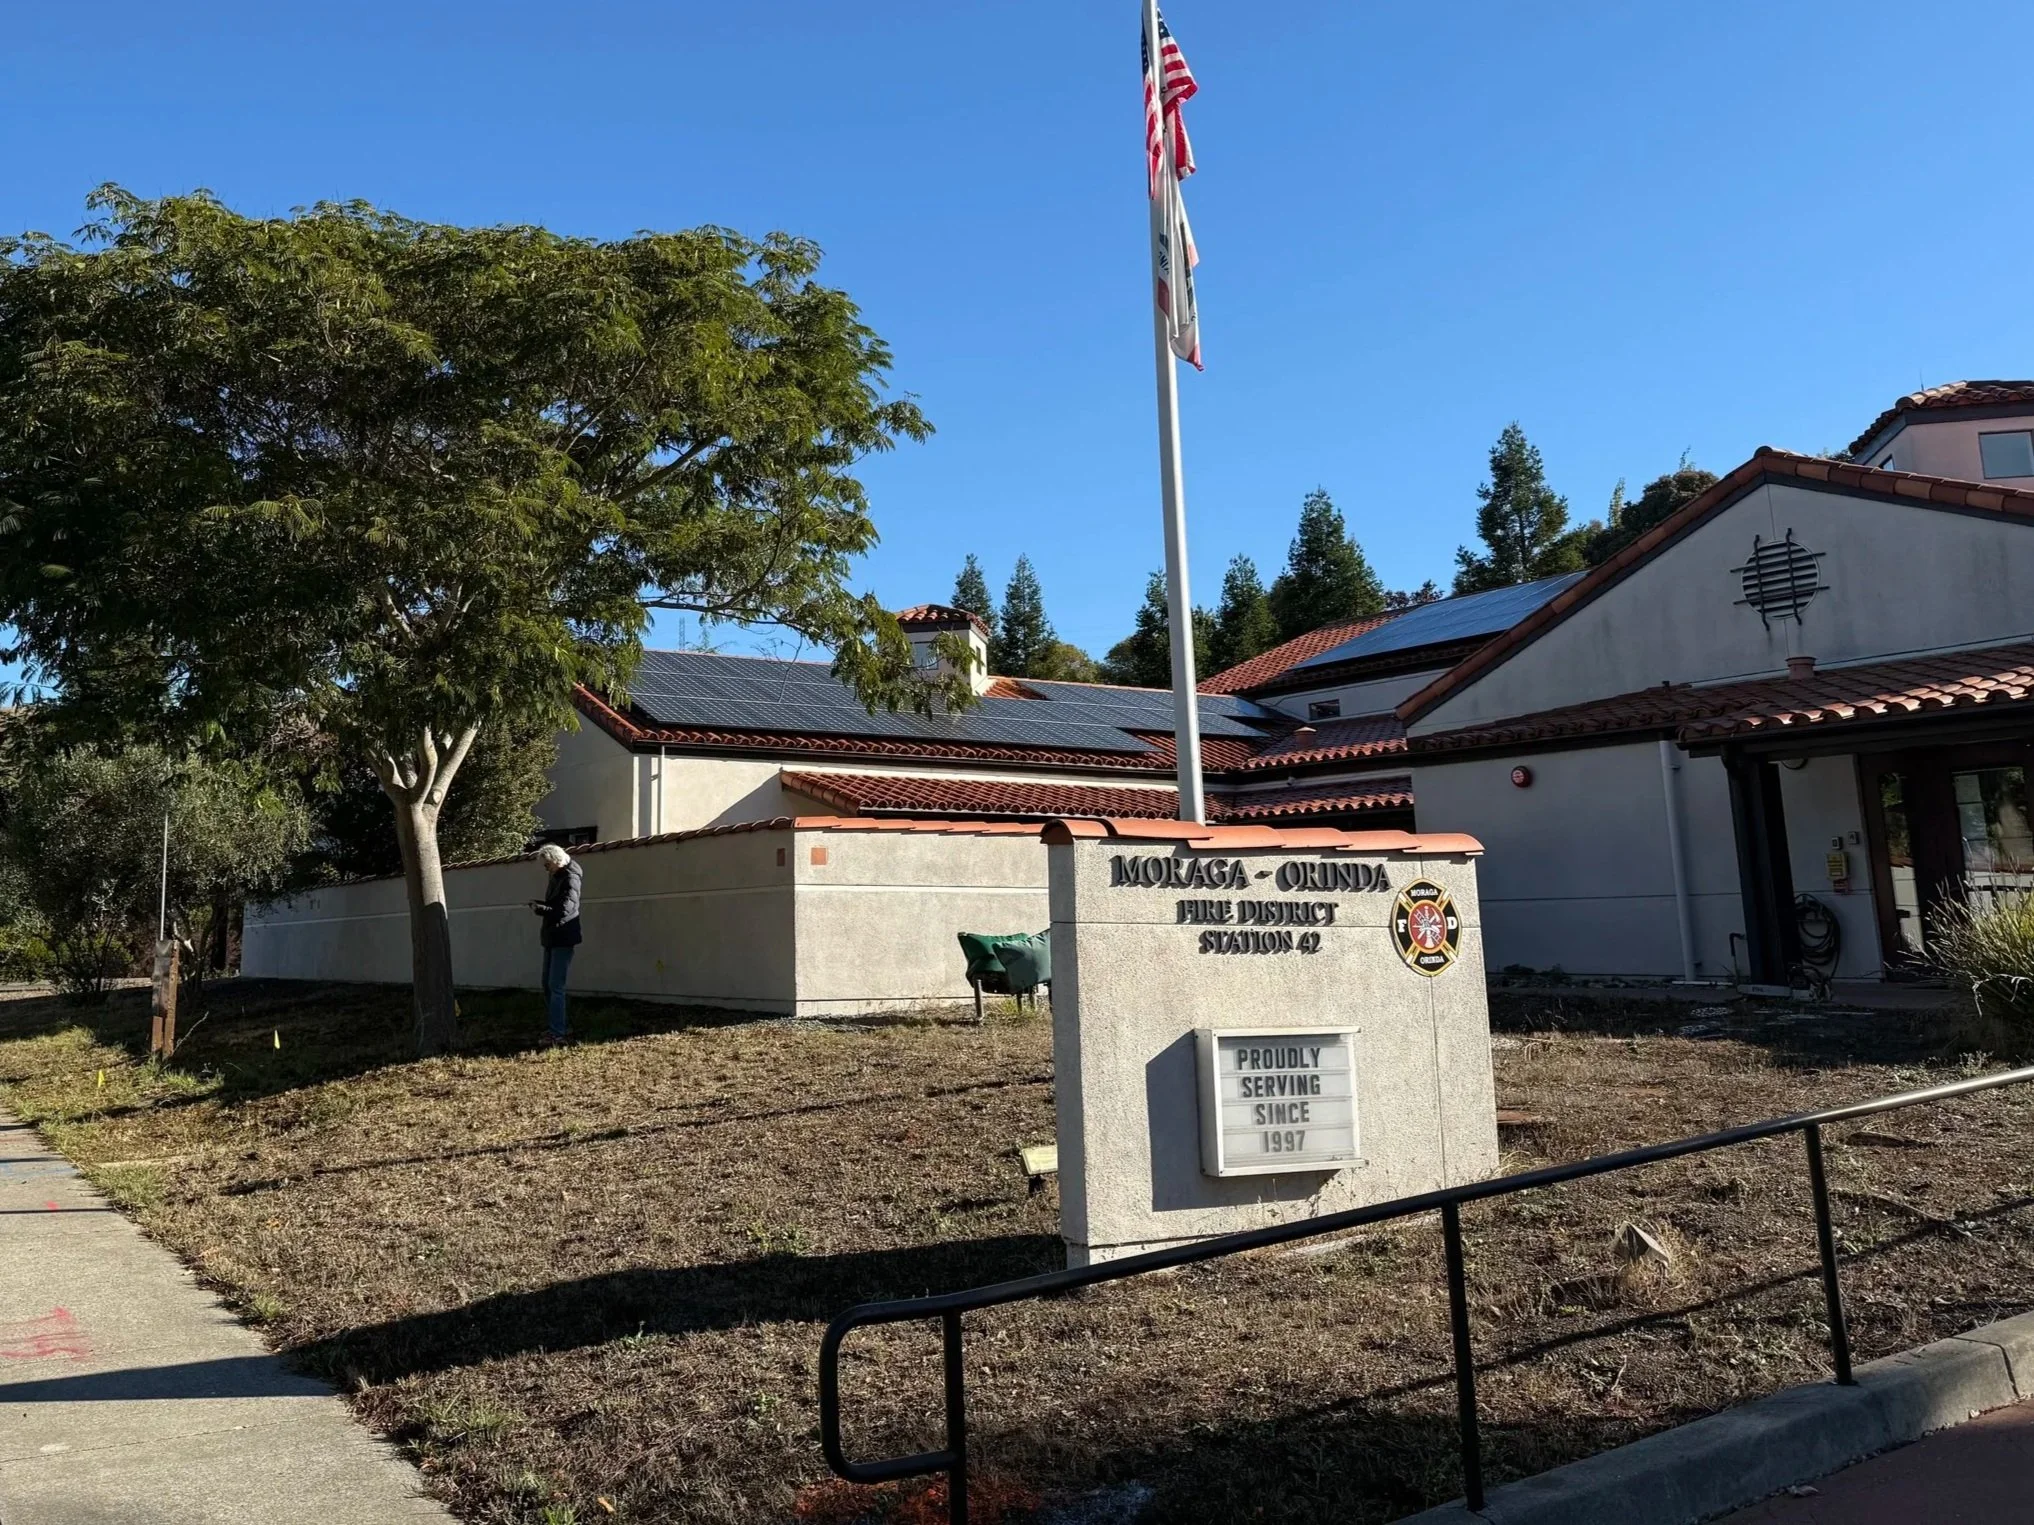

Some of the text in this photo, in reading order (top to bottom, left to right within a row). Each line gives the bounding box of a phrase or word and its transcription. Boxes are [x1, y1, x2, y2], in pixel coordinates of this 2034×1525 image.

[1112, 855, 1252, 889] MORAGA
[1279, 860, 1393, 891] ORINDA
[1410, 888, 1438, 896] MORAGA
[1177, 899, 1339, 925] FIRE DISTRICT
[1446, 916, 1457, 929] D
[1397, 919, 1407, 932] F
[1200, 930, 1322, 954] STATION 42
[1238, 1048, 1321, 1070] PROUDLY
[1242, 1075, 1321, 1098] SERVING
[1255, 1101, 1310, 1125] SINCE
[1264, 1130, 1305, 1152] 1997
